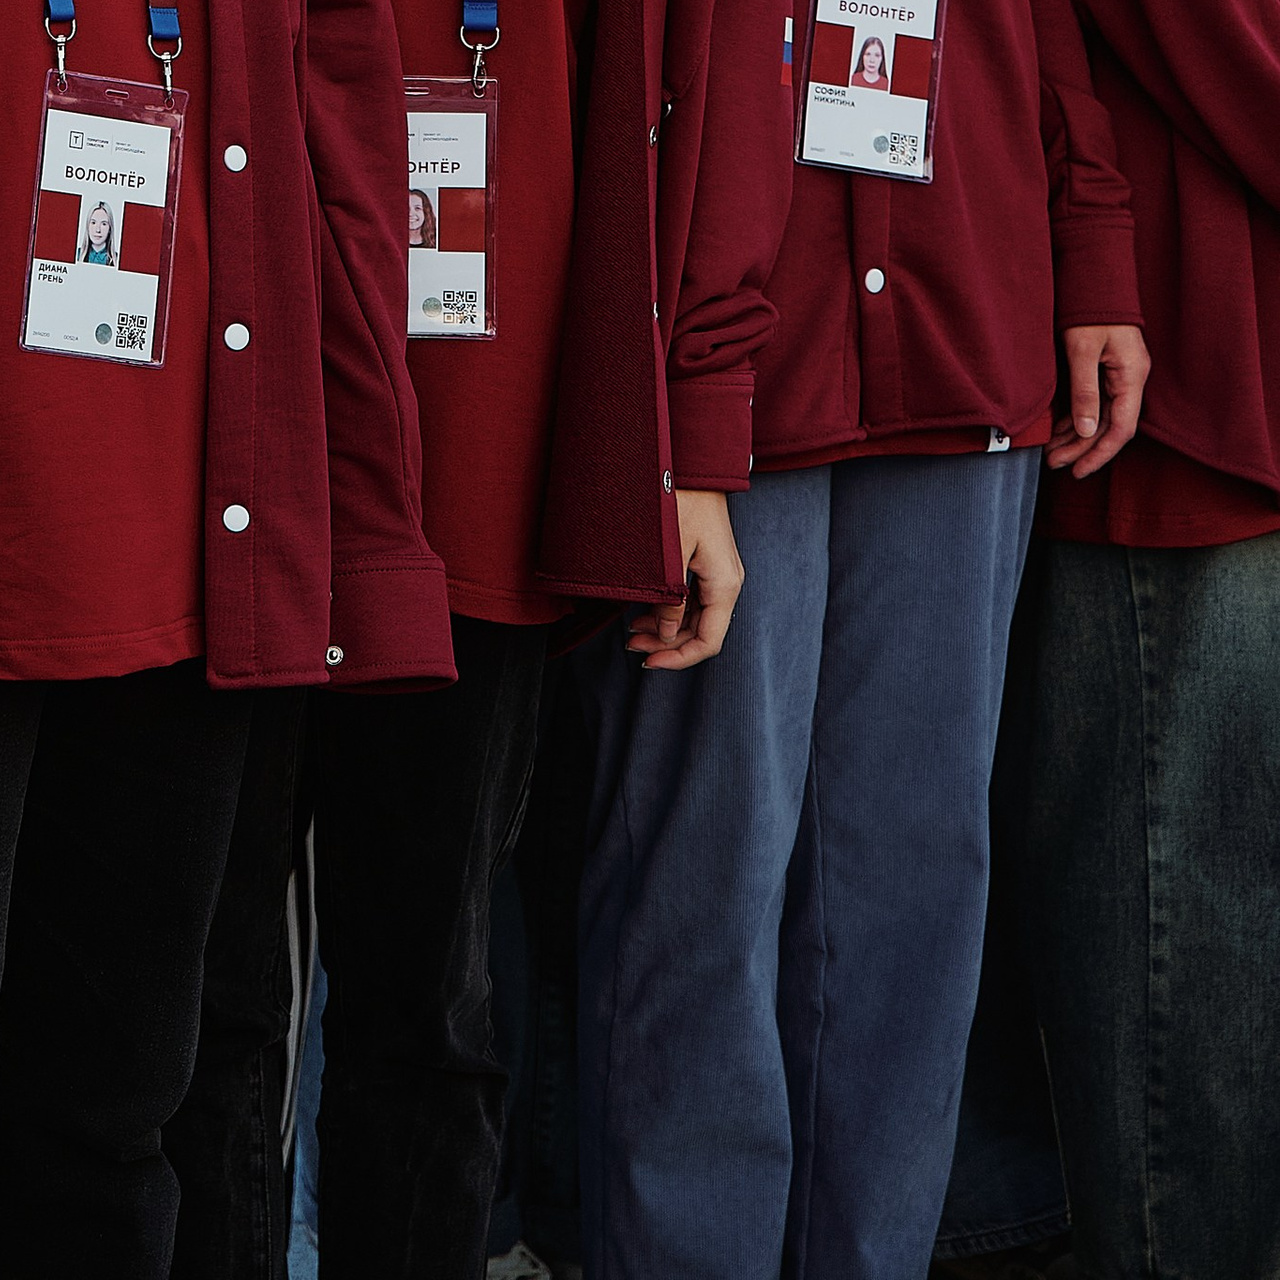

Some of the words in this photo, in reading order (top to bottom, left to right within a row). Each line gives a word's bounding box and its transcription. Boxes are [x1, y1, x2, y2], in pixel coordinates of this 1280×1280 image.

[839, 0, 915, 22] ВОЛОНТЁР
[814, 86, 846, 97] СОФИЯ
[65, 165, 146, 189] ВОЛОНТЁР
[38, 263, 68, 275] ДИАНА
[37, 273, 64, 284] ГРЕНЬ
